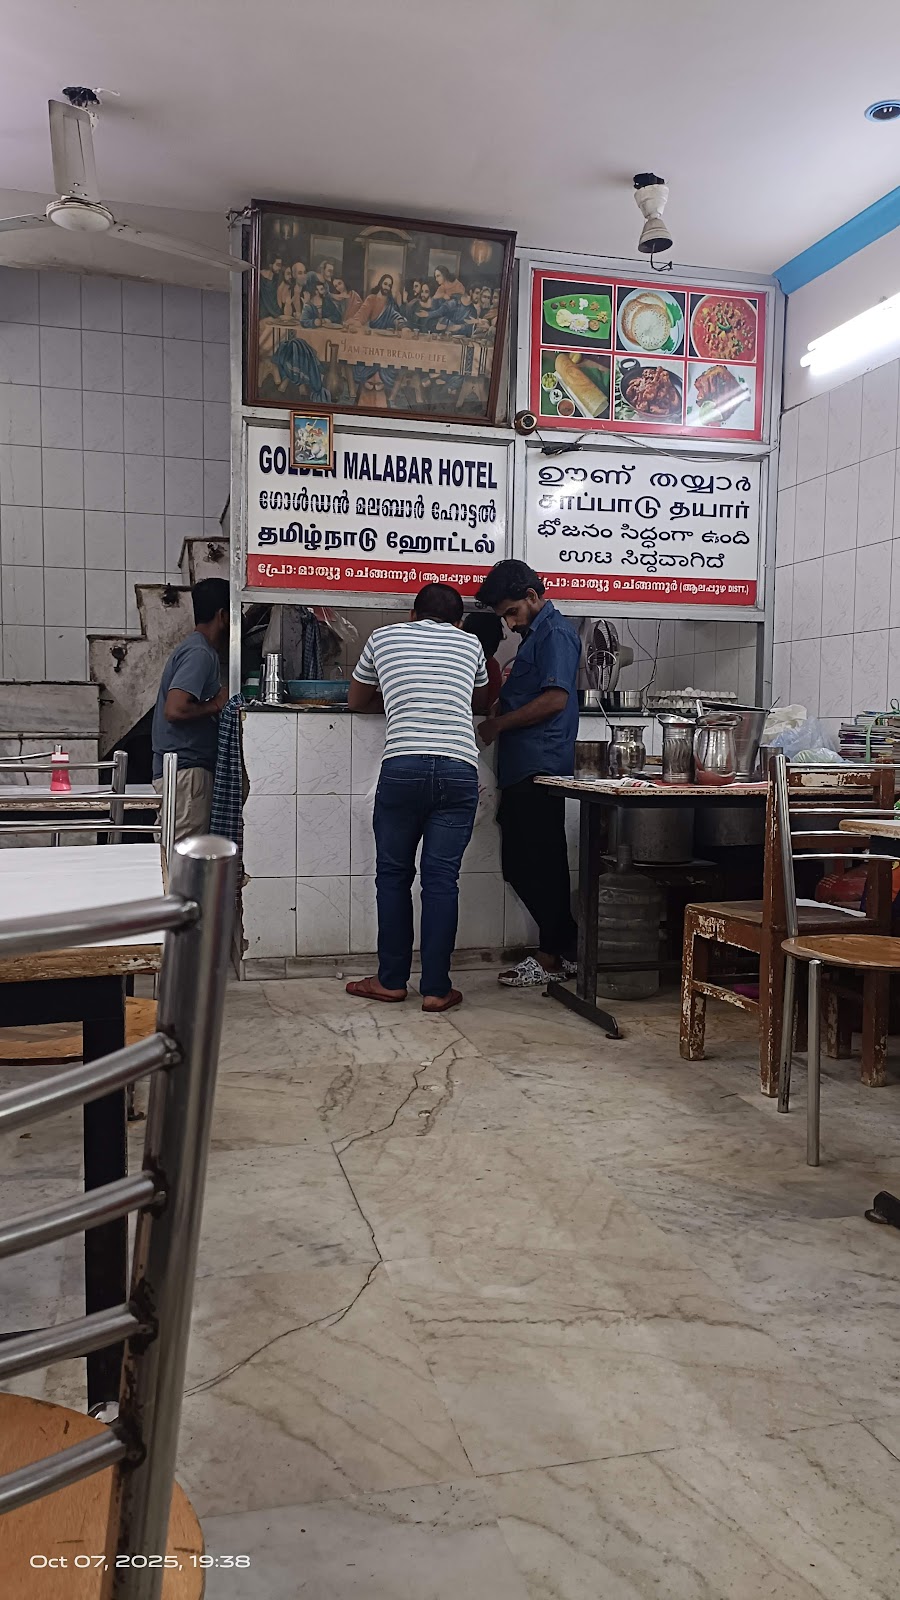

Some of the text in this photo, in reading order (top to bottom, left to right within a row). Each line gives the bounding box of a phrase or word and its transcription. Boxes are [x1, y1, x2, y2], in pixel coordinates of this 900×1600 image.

[363, 347, 384, 356] THAT
[387, 349, 412, 359] BREAD
[415, 352, 425, 360] OF
[429, 354, 446, 362] LIFE
[344, 452, 433, 485] MALABAR
[439, 459, 498, 488] HOTEL
[538, 464, 751, 494] ഊണ് തയ്യാർ
[259, 487, 496, 528] ഗോൾഡൻ മലബാർ ഹോട്ടൽ
[538, 492, 750, 521] சாப்பாடு தயார்
[257, 522, 495, 554] தமிழ்நாடு ஹோட்டல்
[537, 518, 613, 538] భోజనం
[621, 524, 694, 549] సిద్ధంగా
[559, 549, 613, 564] ಊಟ
